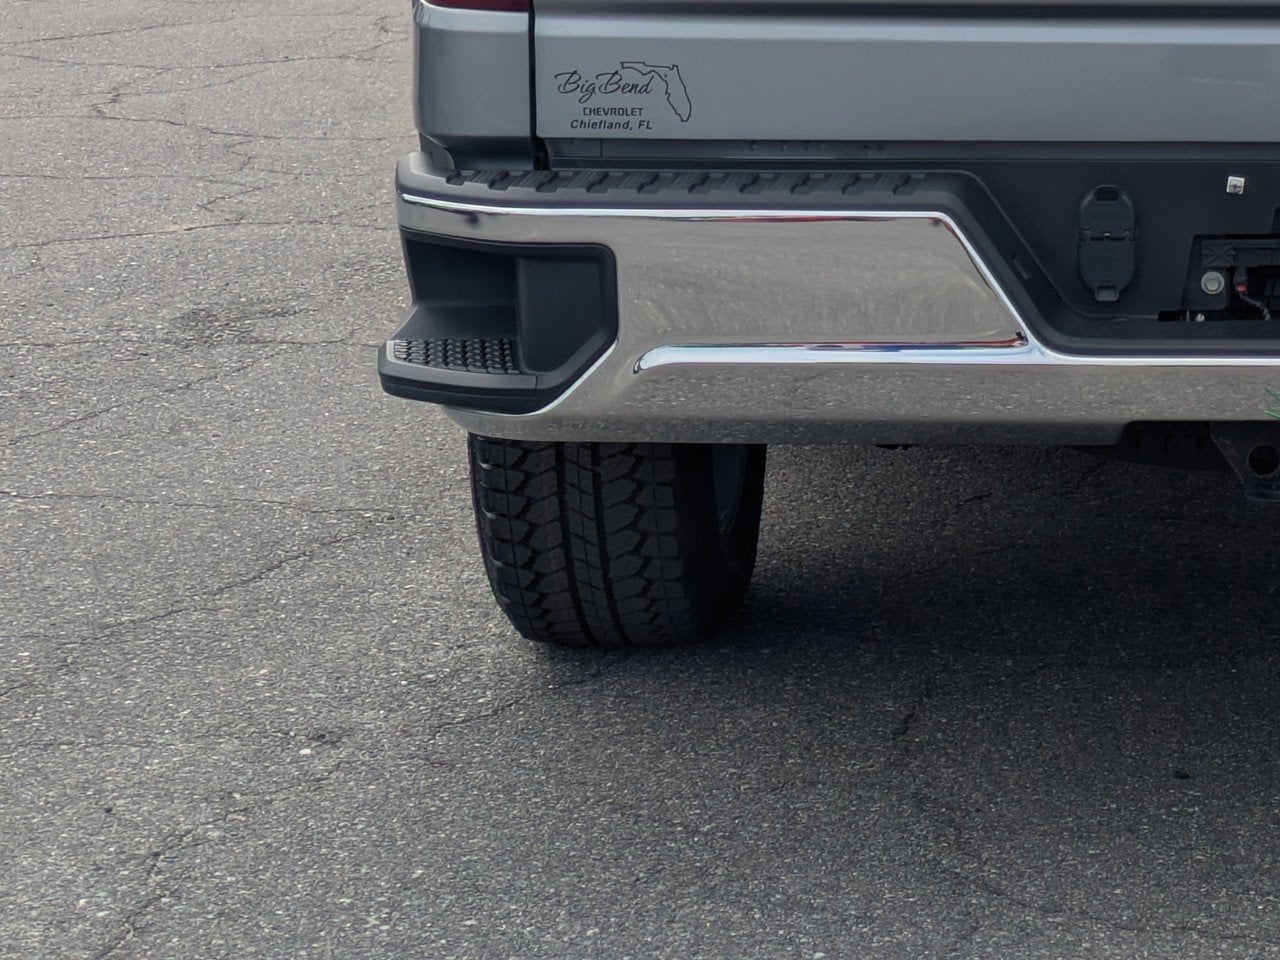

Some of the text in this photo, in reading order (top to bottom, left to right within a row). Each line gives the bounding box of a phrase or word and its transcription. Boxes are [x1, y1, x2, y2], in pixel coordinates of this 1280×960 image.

[554, 69, 655, 104] Big Bend
[582, 106, 644, 117] CHEVROLET
[570, 118, 653, 131] Chiefland, FL
